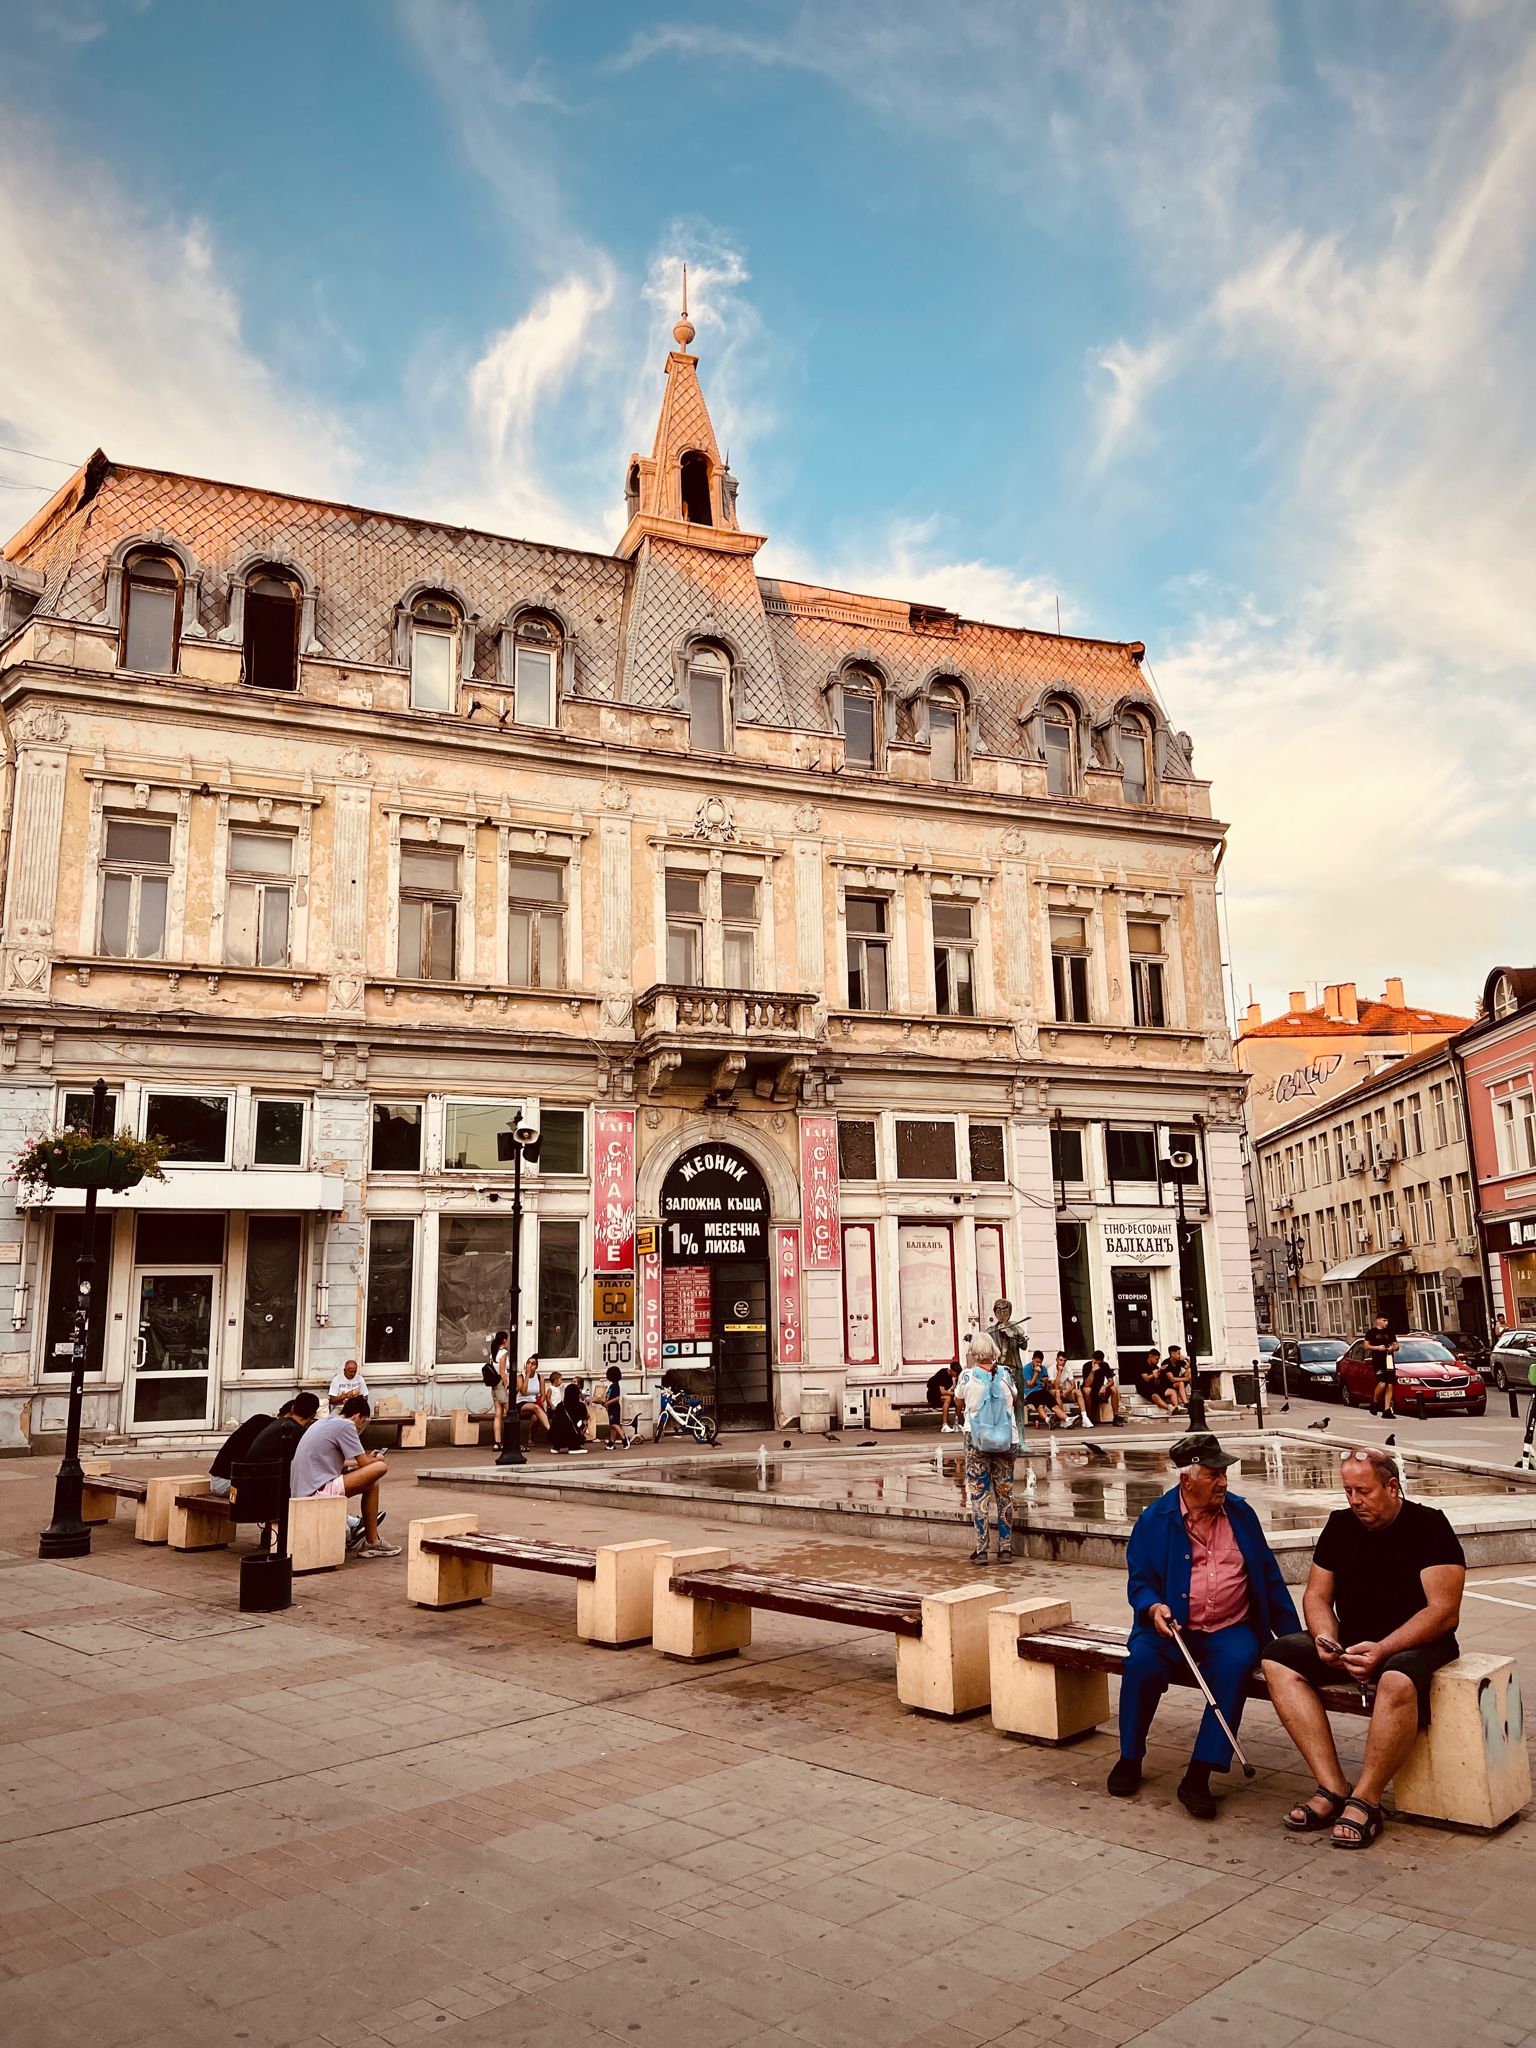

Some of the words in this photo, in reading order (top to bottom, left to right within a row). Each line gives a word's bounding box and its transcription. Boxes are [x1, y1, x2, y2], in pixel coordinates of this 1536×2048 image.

[679, 1154, 749, 1182] ЖЕОНИК
[606, 1141, 624, 1262] CHANGE
[665, 1197, 722, 1211] ЗАЛОЖНА
[727, 1197, 763, 1212] КЪЩА
[813, 1146, 830, 1260] CHANGE
[668, 1223, 699, 1255] 1%
[704, 1223, 761, 1237] МЕСЕЧНА
[704, 1239, 746, 1254] ЛИХВА
[782, 1235, 794, 1278] NON
[906, 1241, 943, 1249] БАЛКАНЪ
[1105, 1237, 1174, 1253] БАЛКАНЪ
[645, 1253, 658, 1280] ON
[597, 1280, 631, 1288] ЗЛАТО
[602, 1292, 626, 1315] 62
[646, 1299, 658, 1361] STOP
[784, 1296, 796, 1356] STOP
